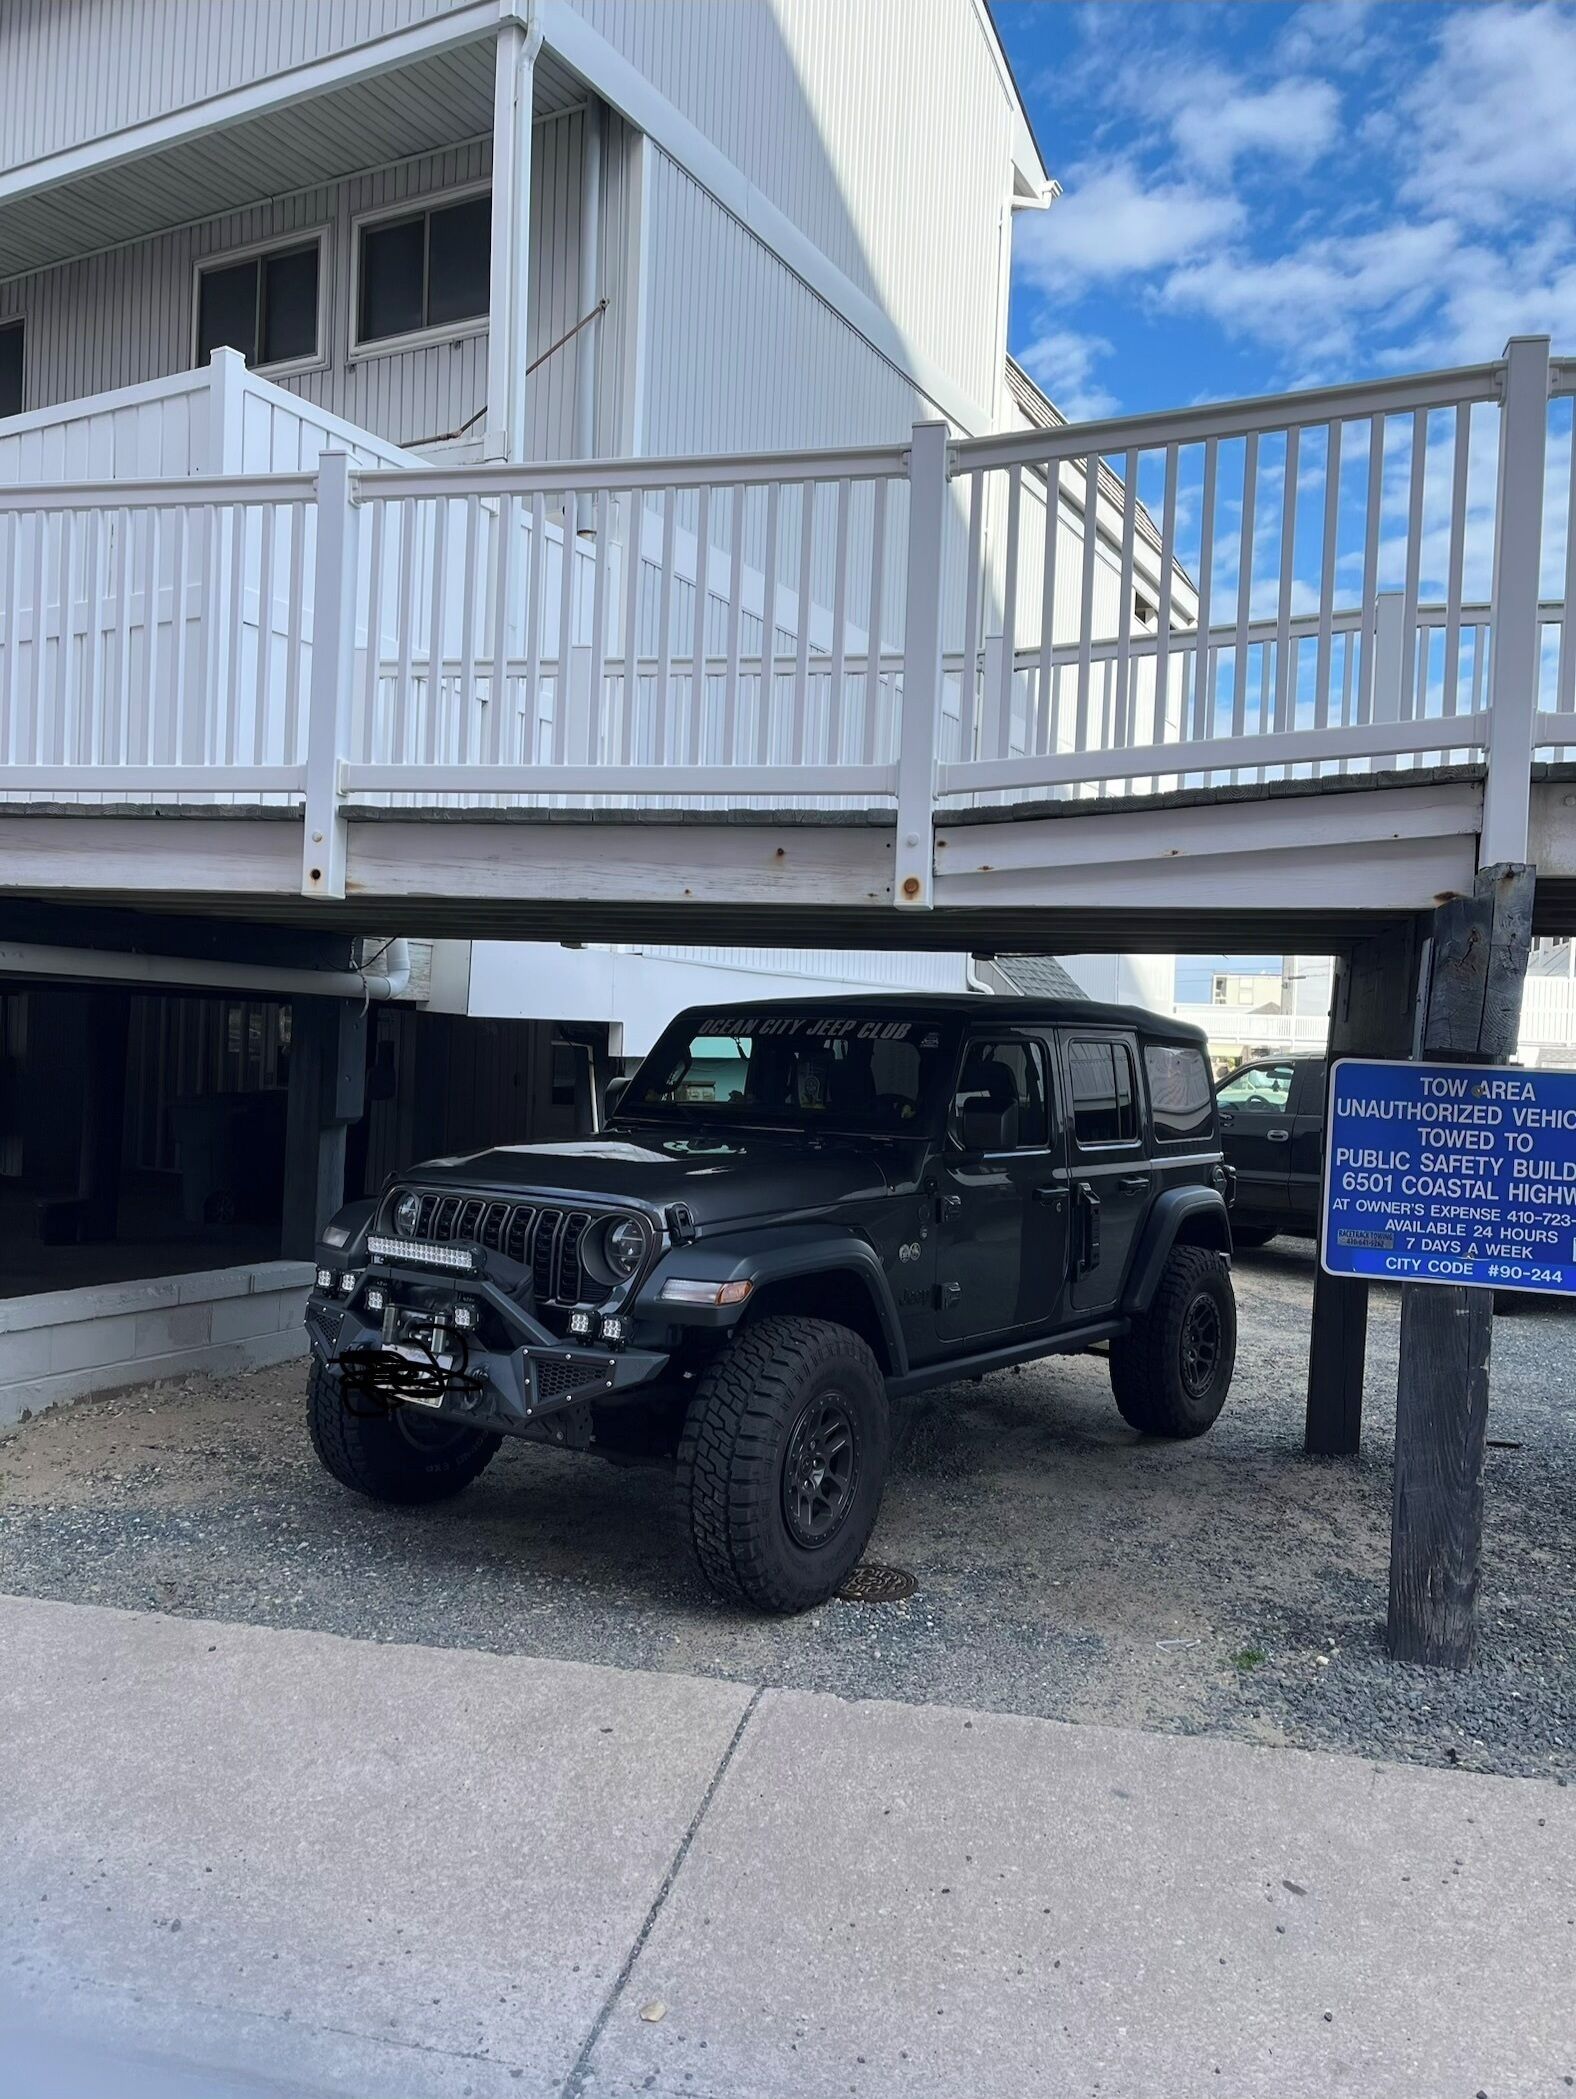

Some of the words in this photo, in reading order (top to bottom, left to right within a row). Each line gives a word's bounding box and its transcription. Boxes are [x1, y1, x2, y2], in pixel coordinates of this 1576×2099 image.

[698, 1019, 758, 1035] OCEAN
[758, 1019, 806, 1036] CITY
[806, 1020, 858, 1037] JEEP
[857, 1022, 912, 1039] CLUB
[1420, 1077, 1468, 1098] TOW
[1479, 1080, 1536, 1101] AREA
[1337, 1099, 1502, 1125] UNAUTHORIZED
[1512, 1107, 1576, 1130] VEHIC
[1418, 1128, 1494, 1150] TOWED
[1504, 1133, 1533, 1152] TO
[1336, 1148, 1410, 1170] PUBLIC
[1420, 1152, 1504, 1176] SAFETY
[1513, 1158, 1576, 1181] BUILD
[1342, 1172, 1393, 1193] 6501
[1402, 1175, 1499, 1200] COASTAL
[1332, 1198, 1350, 1211] AT
[1356, 1200, 1425, 1216] OWNER'S
[1431, 1205, 1501, 1221] EXPENSE
[1385, 1219, 1466, 1236] AVAILABLE
[1474, 1225, 1493, 1238] 24
[1501, 1227, 1558, 1244] HOURS
[1406, 1237, 1415, 1250] 7
[1421, 1239, 1461, 1254] DAYS
[1468, 1242, 1478, 1255] A
[1486, 1243, 1533, 1260] WEEK
[1386, 1257, 1422, 1271] CITY
[1428, 1259, 1474, 1275] CODE
[1488, 1264, 1563, 1283] #90-244
